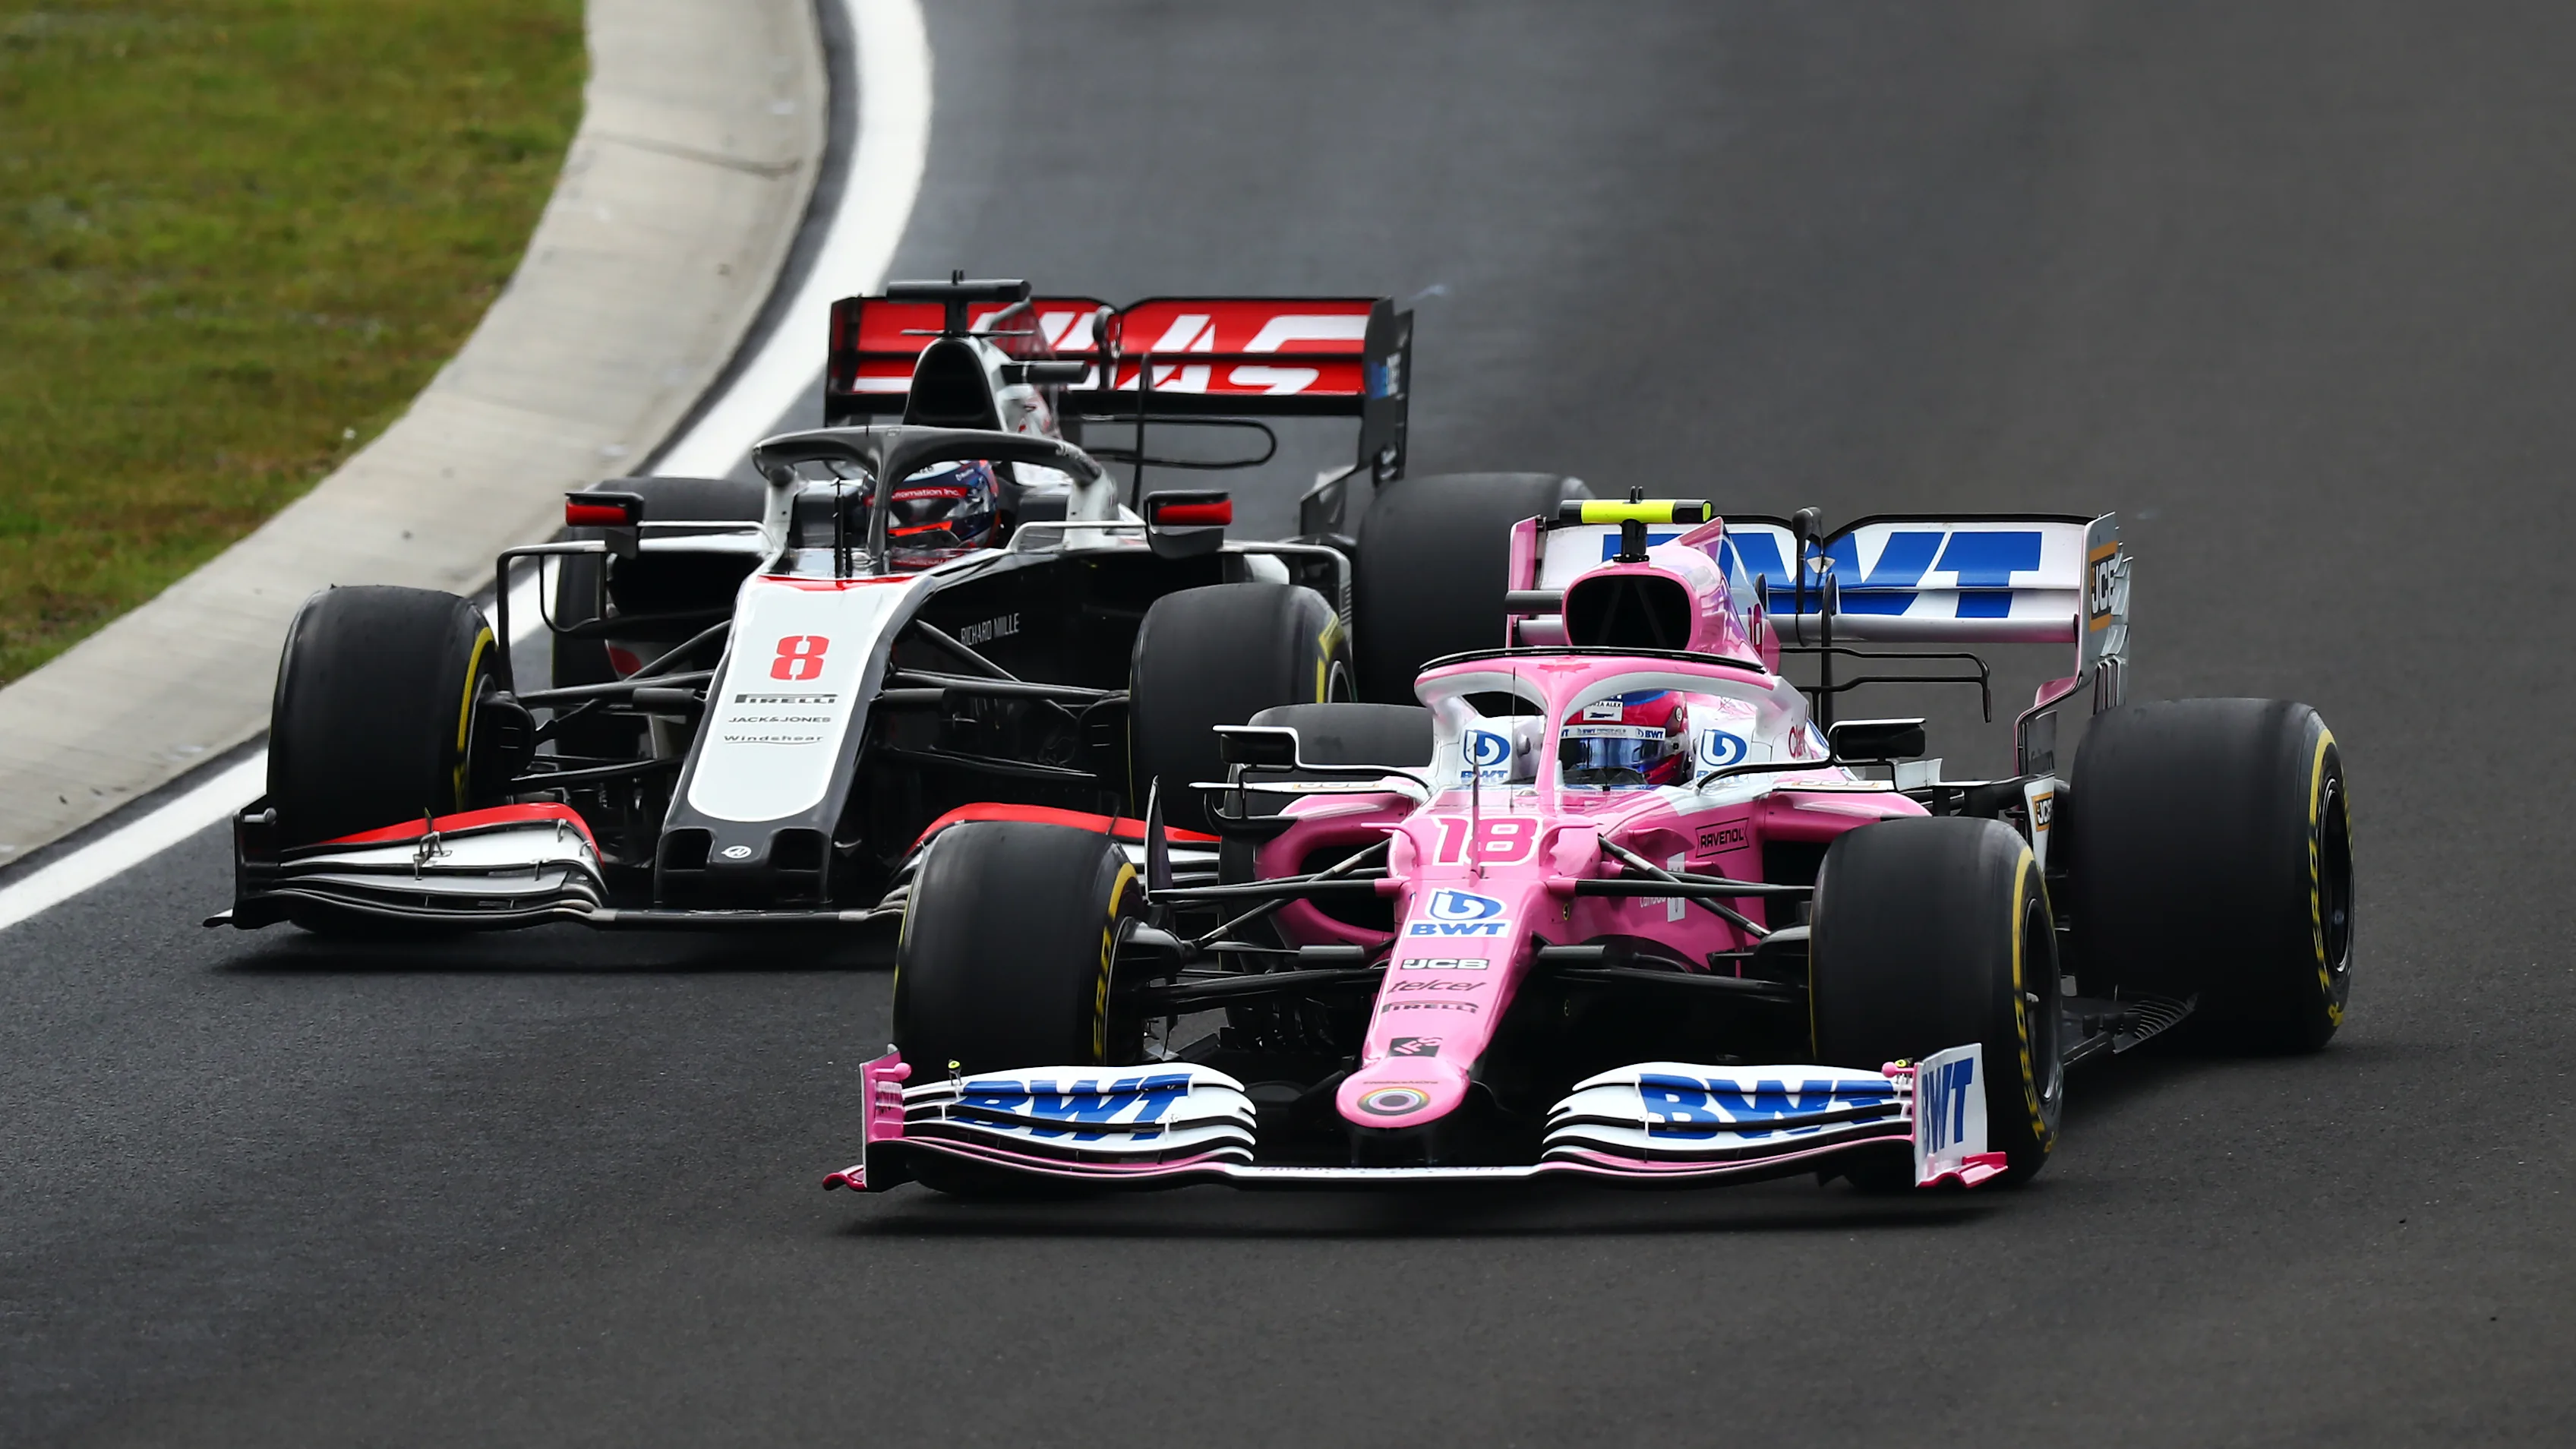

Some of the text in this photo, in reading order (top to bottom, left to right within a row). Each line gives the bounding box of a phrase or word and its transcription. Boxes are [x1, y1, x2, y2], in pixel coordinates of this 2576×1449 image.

[961, 612, 1020, 646] RICHARD MILLE
[770, 636, 829, 680] 8
[734, 693, 838, 704] PIRELLI
[1645, 730, 1664, 739] BWT
[1433, 816, 1542, 865] 18
[1700, 828, 1744, 849] RAVENOL
[1410, 923, 1506, 935] BWT
[1401, 958, 1489, 970] JCB
[1387, 980, 1487, 994] telcel
[1381, 1000, 1479, 1015] PIRELLI
[947, 1073, 1194, 1141] BWT
[1640, 1073, 1894, 1140] BWT
[1922, 1057, 1974, 1157] BWT
